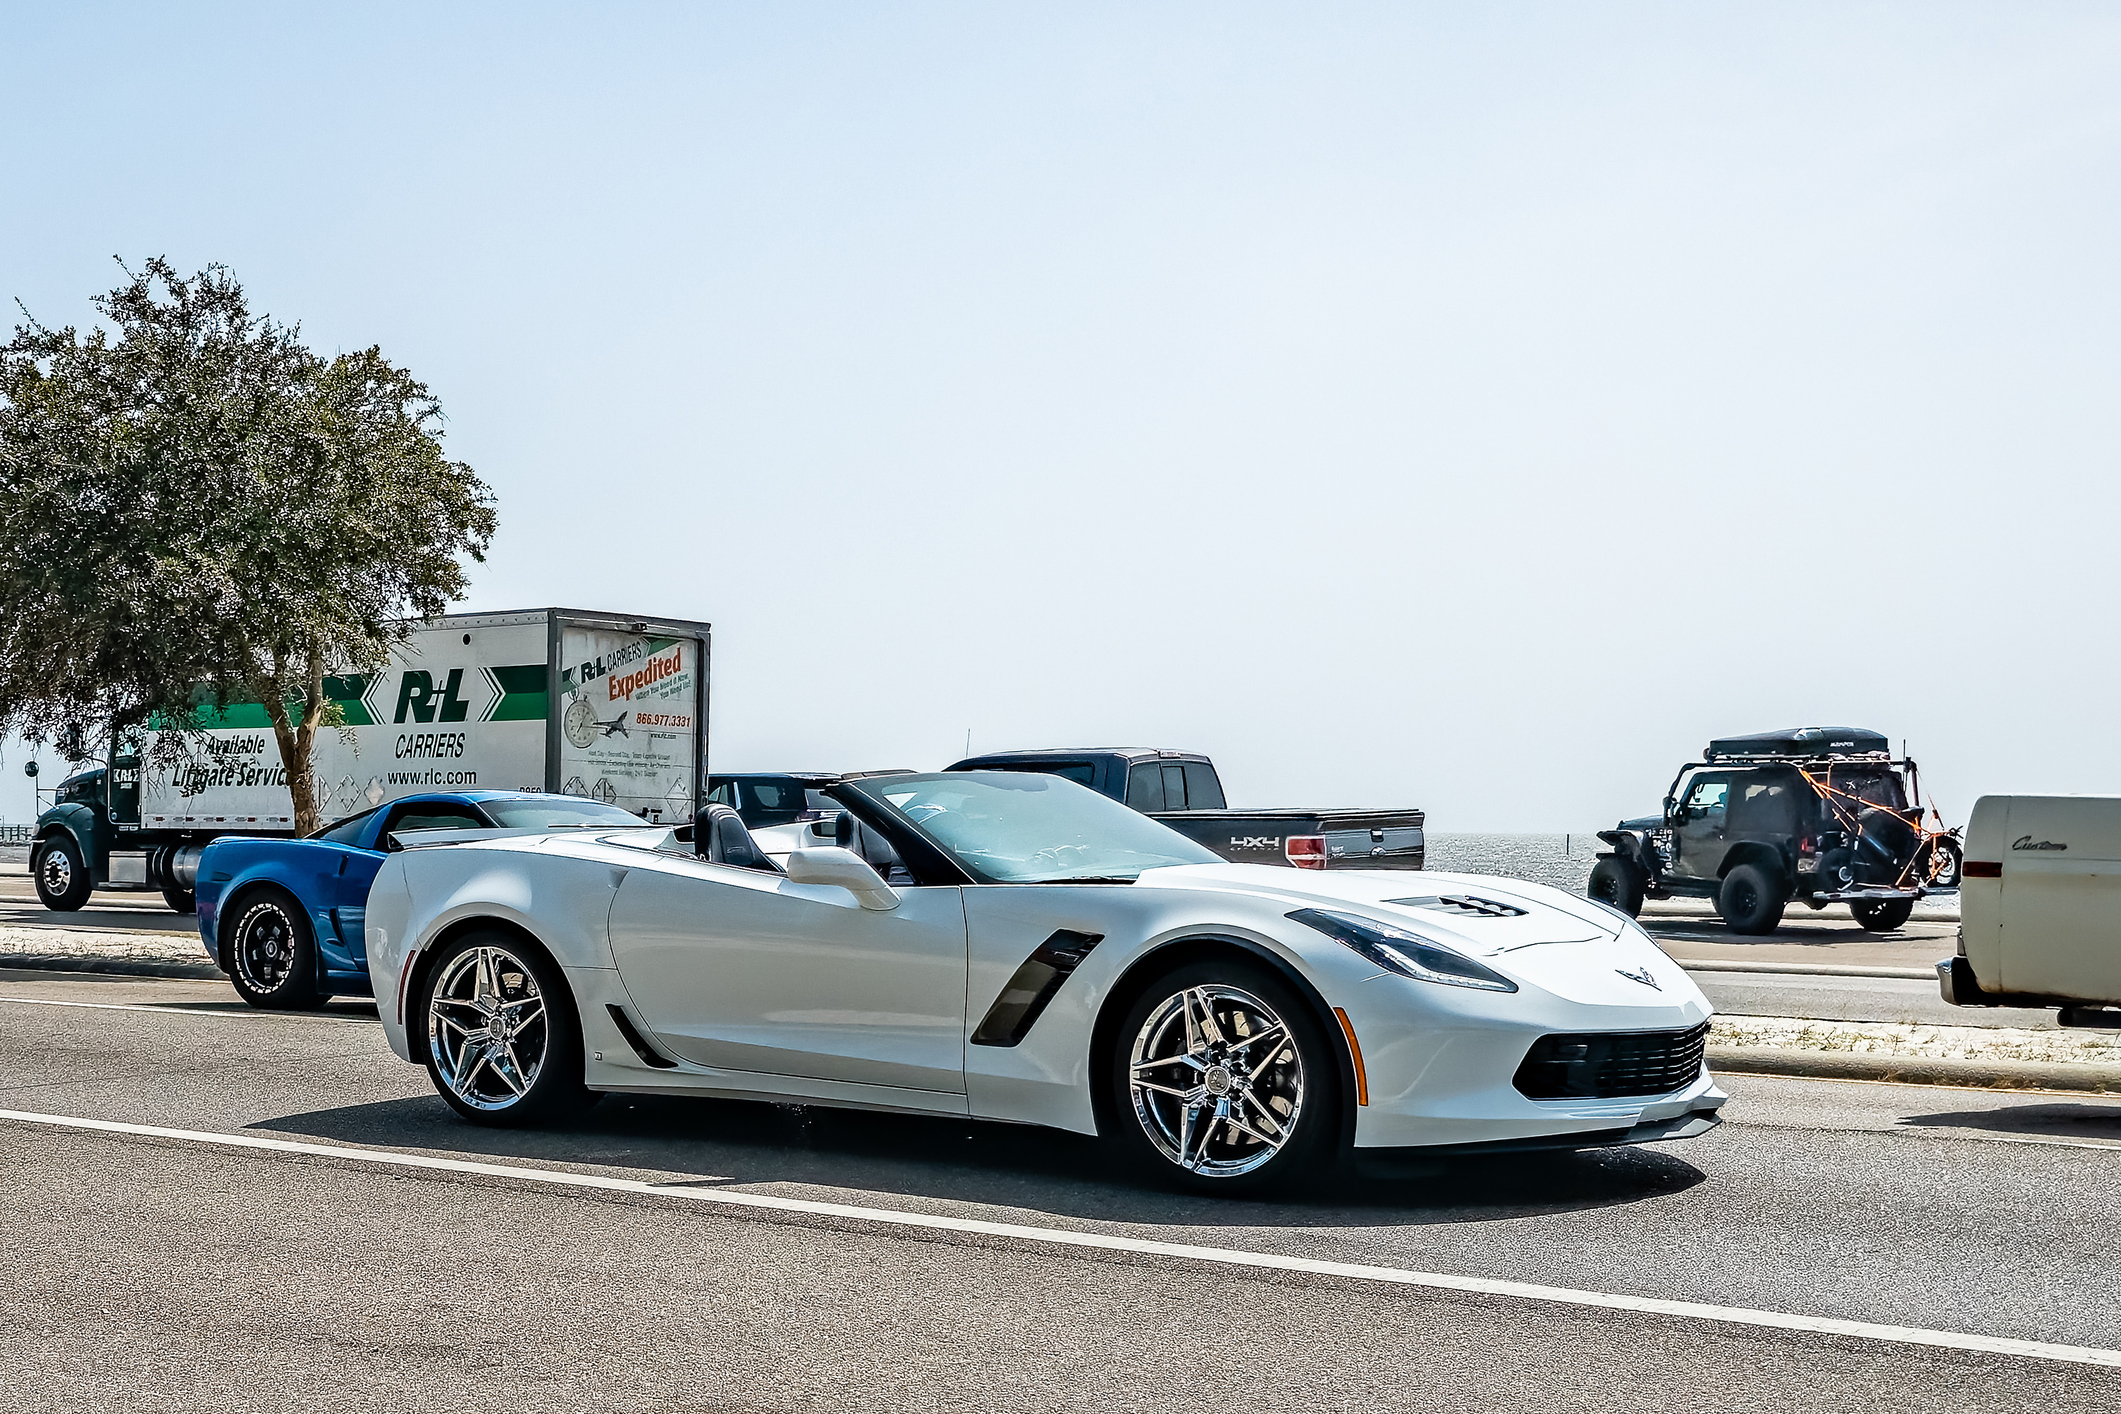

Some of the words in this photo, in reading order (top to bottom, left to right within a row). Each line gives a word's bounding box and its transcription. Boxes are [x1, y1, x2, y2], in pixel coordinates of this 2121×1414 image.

[608, 647, 681, 701] Expedited
[636, 713, 690, 727] 866.977.3331
[205, 735, 265, 755] Available
[395, 732, 466, 759] CARRIERS
[237, 762, 289, 786] Servic
[388, 768, 477, 785] www.rlc.com
